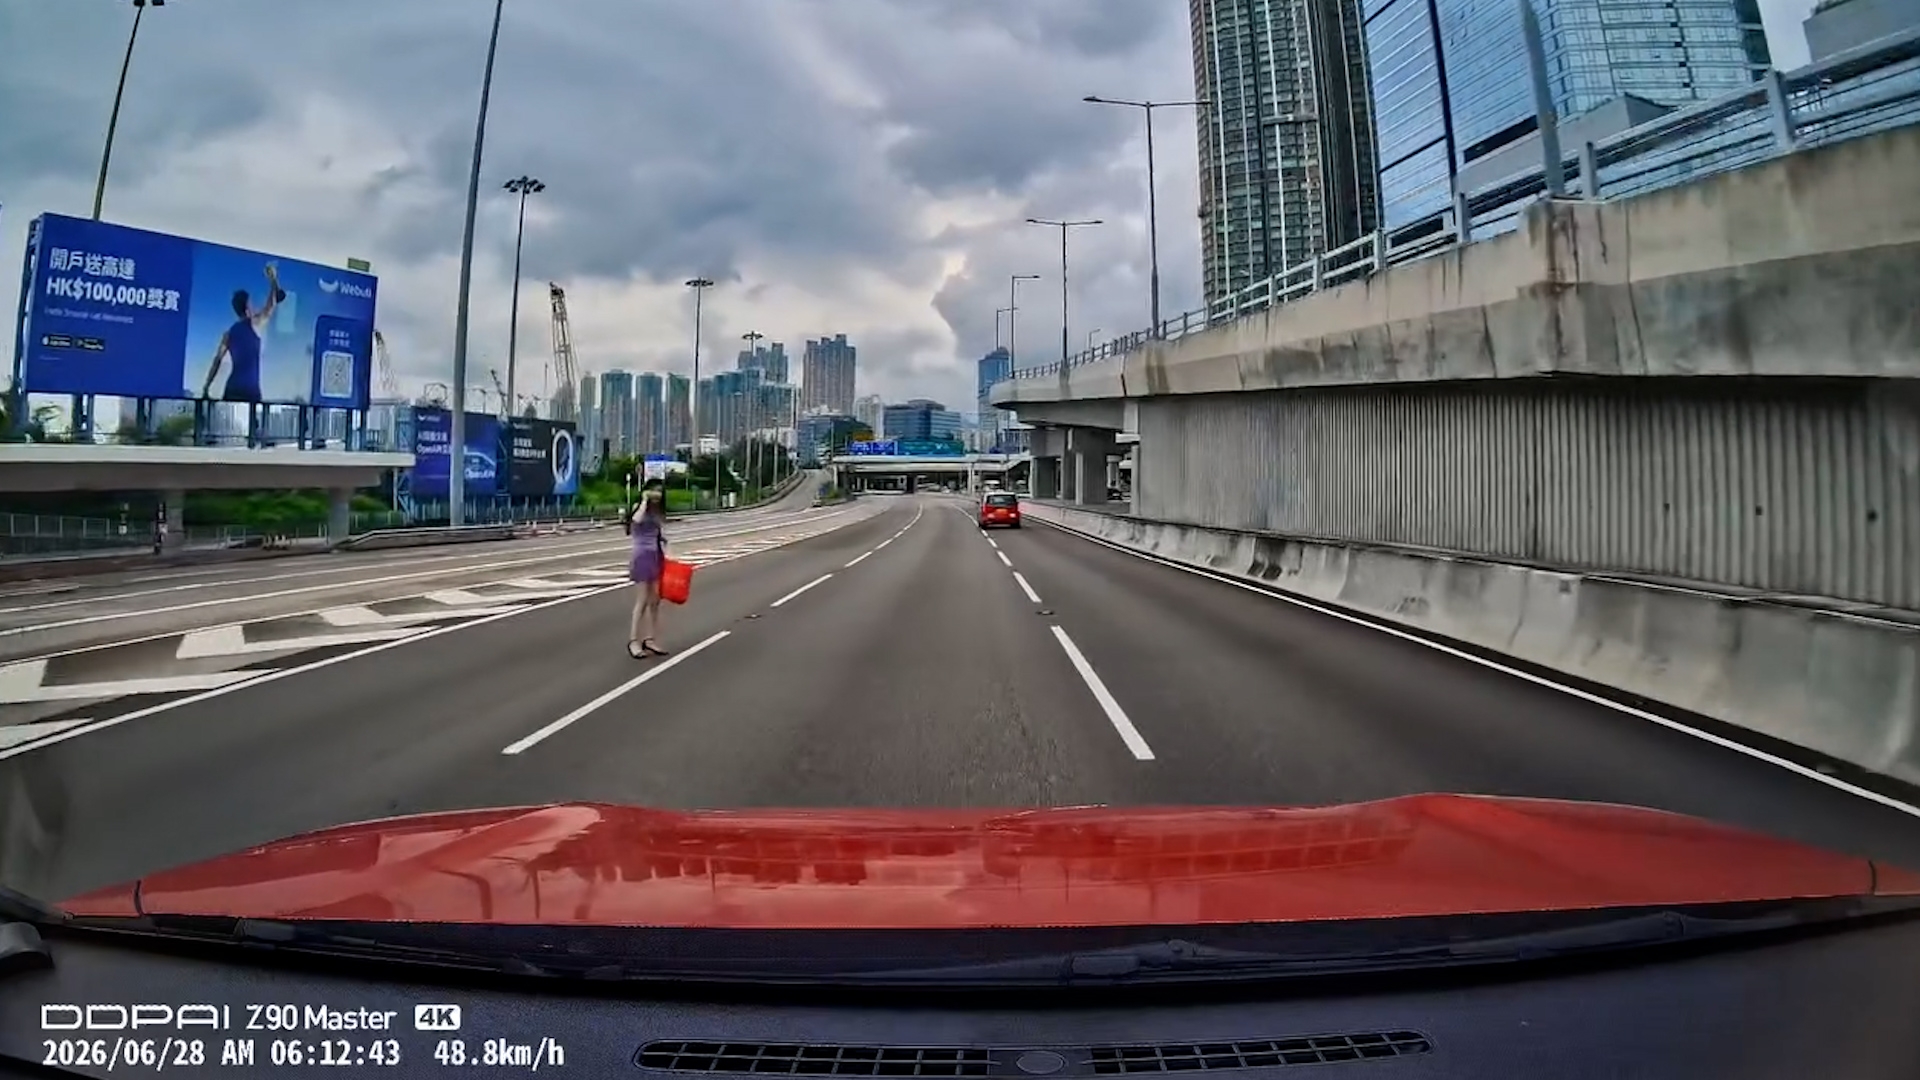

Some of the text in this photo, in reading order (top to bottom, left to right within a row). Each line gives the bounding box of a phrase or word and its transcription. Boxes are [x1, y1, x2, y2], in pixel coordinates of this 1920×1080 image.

[49, 247, 135, 280] 開戶送高達
